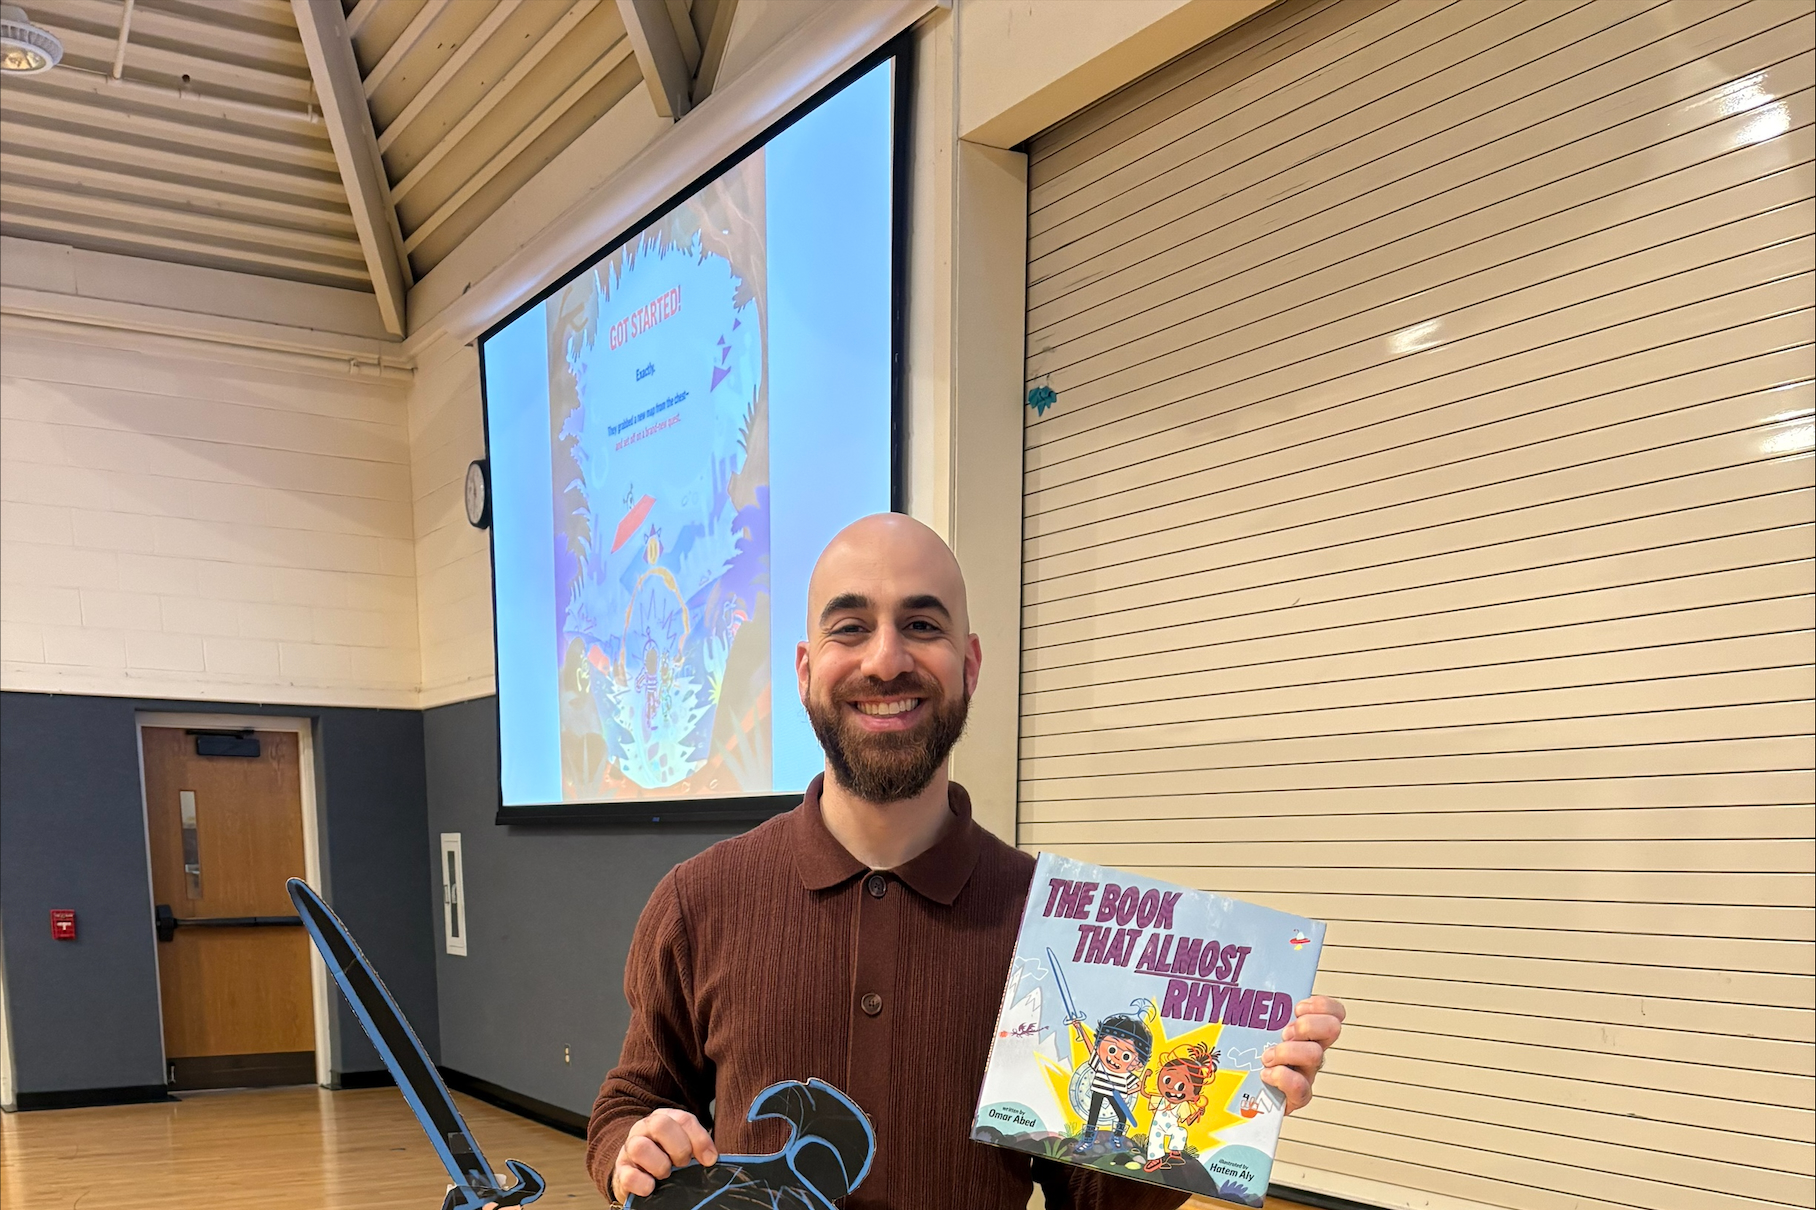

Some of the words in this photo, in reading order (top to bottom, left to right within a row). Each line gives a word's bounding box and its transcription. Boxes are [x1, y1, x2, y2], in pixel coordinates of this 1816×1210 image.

[610, 316, 629, 351] GOT
[630, 284, 682, 339] STARTED!
[1042, 877, 1100, 920] THE
[1095, 882, 1183, 930] BOOK
[1072, 924, 1144, 968] THAT
[1135, 932, 1253, 984] ALMOST
[1160, 978, 1293, 1031] RHYMED
[988, 1108, 1013, 1122] Omar
[1012, 1114, 1037, 1128] Abed
[1002, 1106, 1019, 1114] written
[1210, 1163, 1239, 1178] Hatem
[1239, 1170, 1255, 1182] Aly
[1219, 1158, 1243, 1169] illustrated
